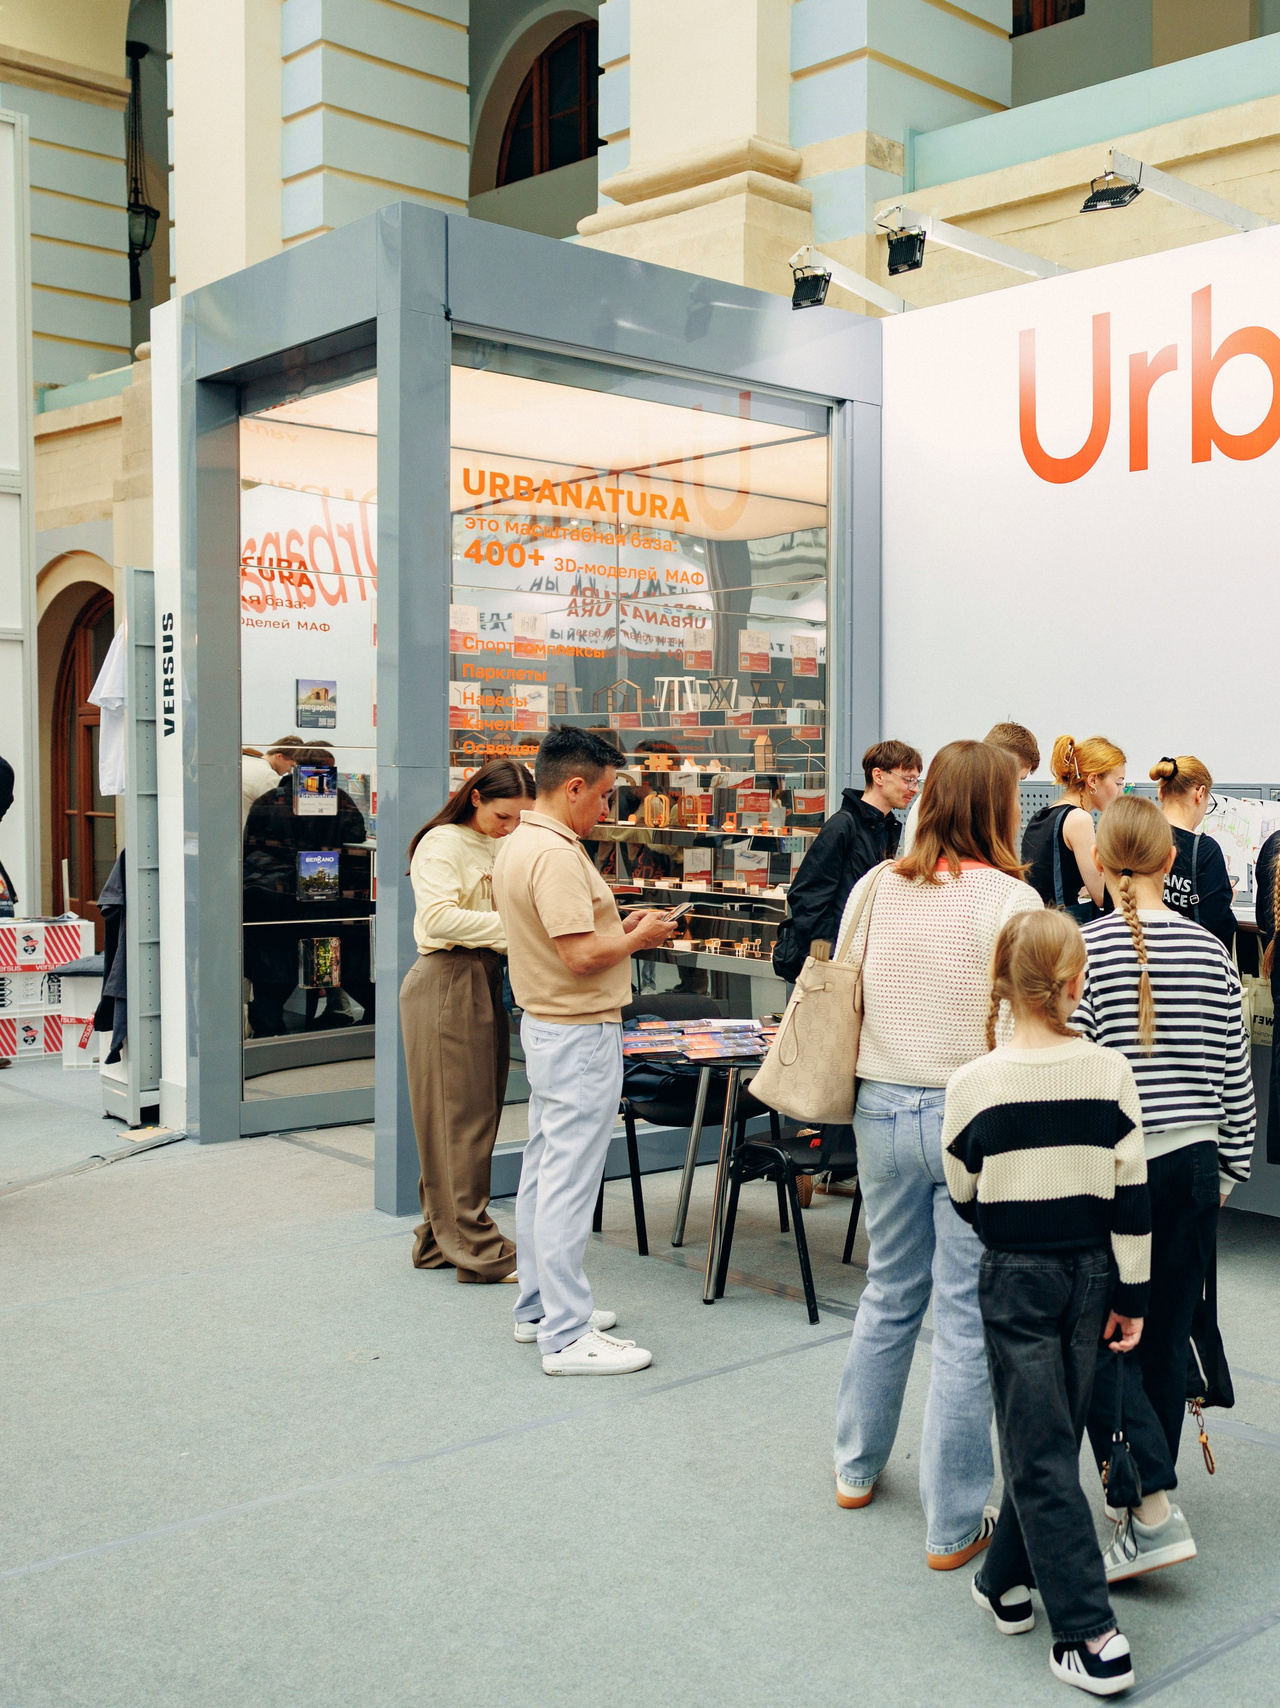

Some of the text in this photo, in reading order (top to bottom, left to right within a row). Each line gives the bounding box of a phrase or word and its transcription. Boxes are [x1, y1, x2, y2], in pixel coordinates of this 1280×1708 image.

[462, 468, 690, 522] URBANATURA
[464, 516, 678, 552] это масштабная база:
[464, 539, 545, 568] 400+
[554, 557, 657, 581] 3D-моделей
[666, 568, 705, 586] МАФ
[297, 620, 331, 632] МАФ
[463, 636, 605, 659] Спорткомплексы
[162, 612, 175, 737] VERSUS
[463, 664, 547, 682] Парклеты
[463, 692, 527, 707] Навесы
[463, 716, 525, 731] Качели
[463, 740, 540, 757] Освещен
[1163, 873, 1192, 893] ANS
[1162, 889, 1188, 908] ACE
